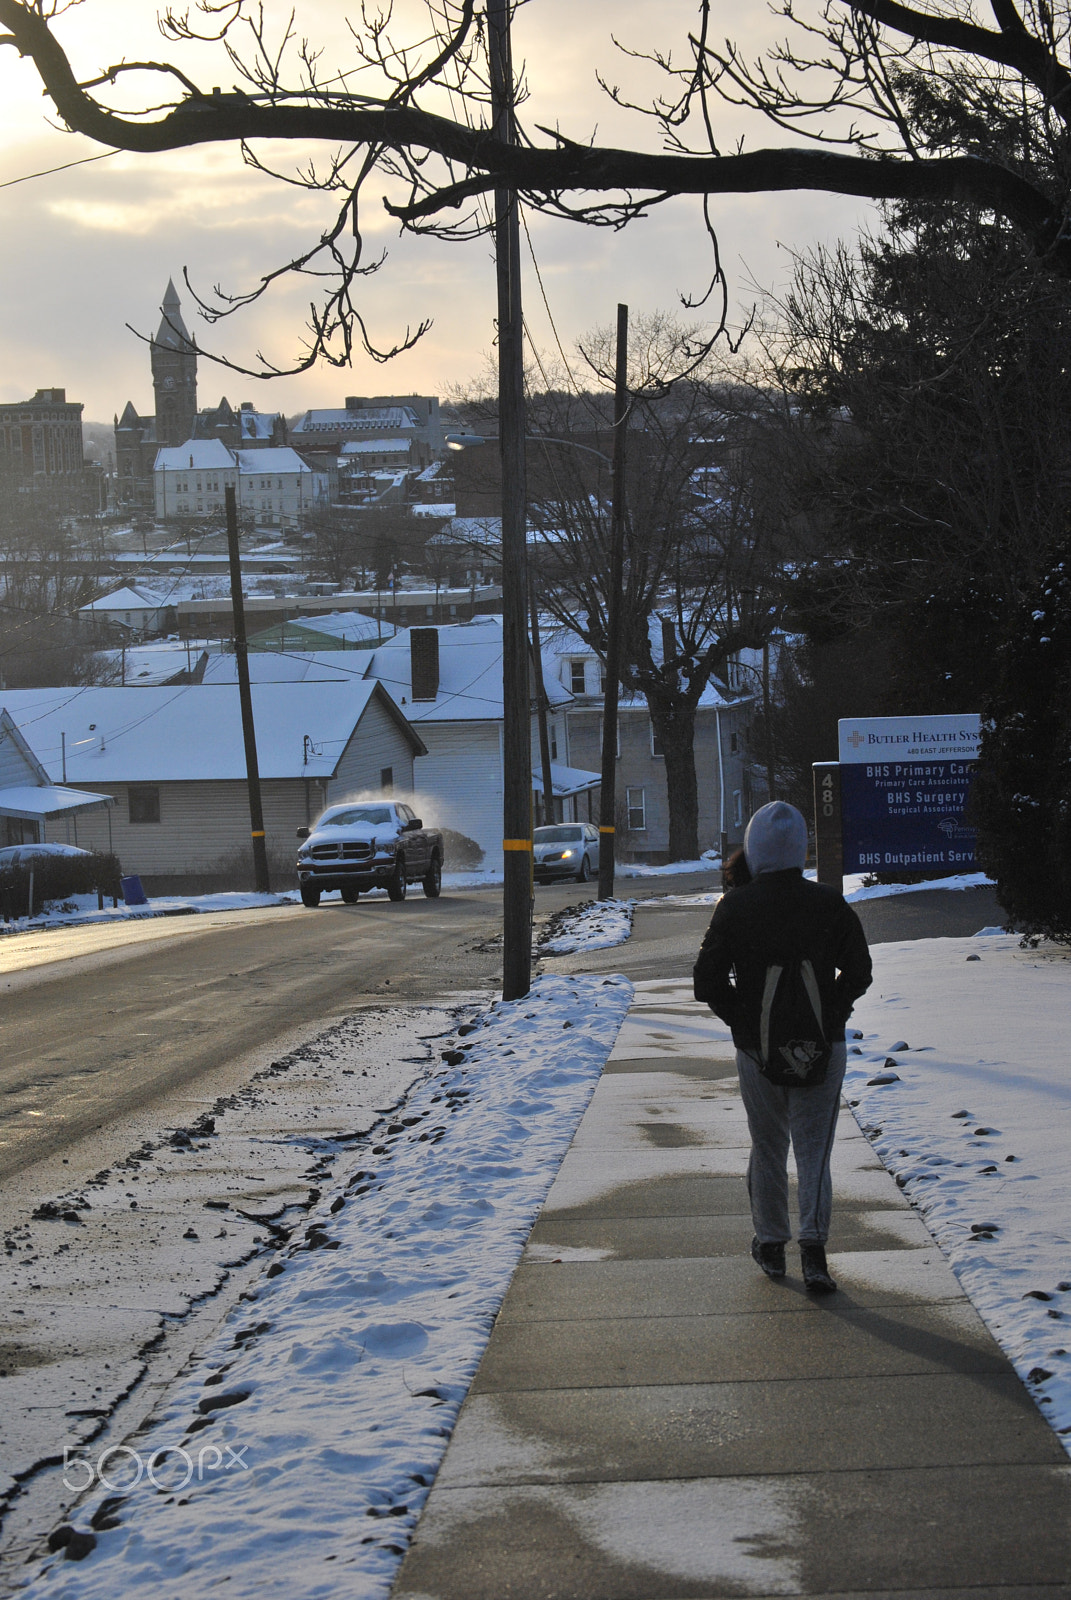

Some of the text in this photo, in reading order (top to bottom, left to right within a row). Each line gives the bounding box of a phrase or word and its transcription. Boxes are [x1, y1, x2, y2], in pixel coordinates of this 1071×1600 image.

[912, 731, 956, 743] HEALTH
[920, 747, 937, 755] EAST
[938, 746, 975, 754] JEFFERSON
[866, 765, 890, 777] BHS
[895, 764, 945, 778] Primary
[875, 777, 970, 788] Primary Care Associates
[821, 773, 834, 817] 480
[887, 791, 965, 805] BHS Surgery
[888, 804, 964, 815] Surgical Associates
[859, 852, 881, 865] BHS
[884, 851, 945, 865] Outpatient
